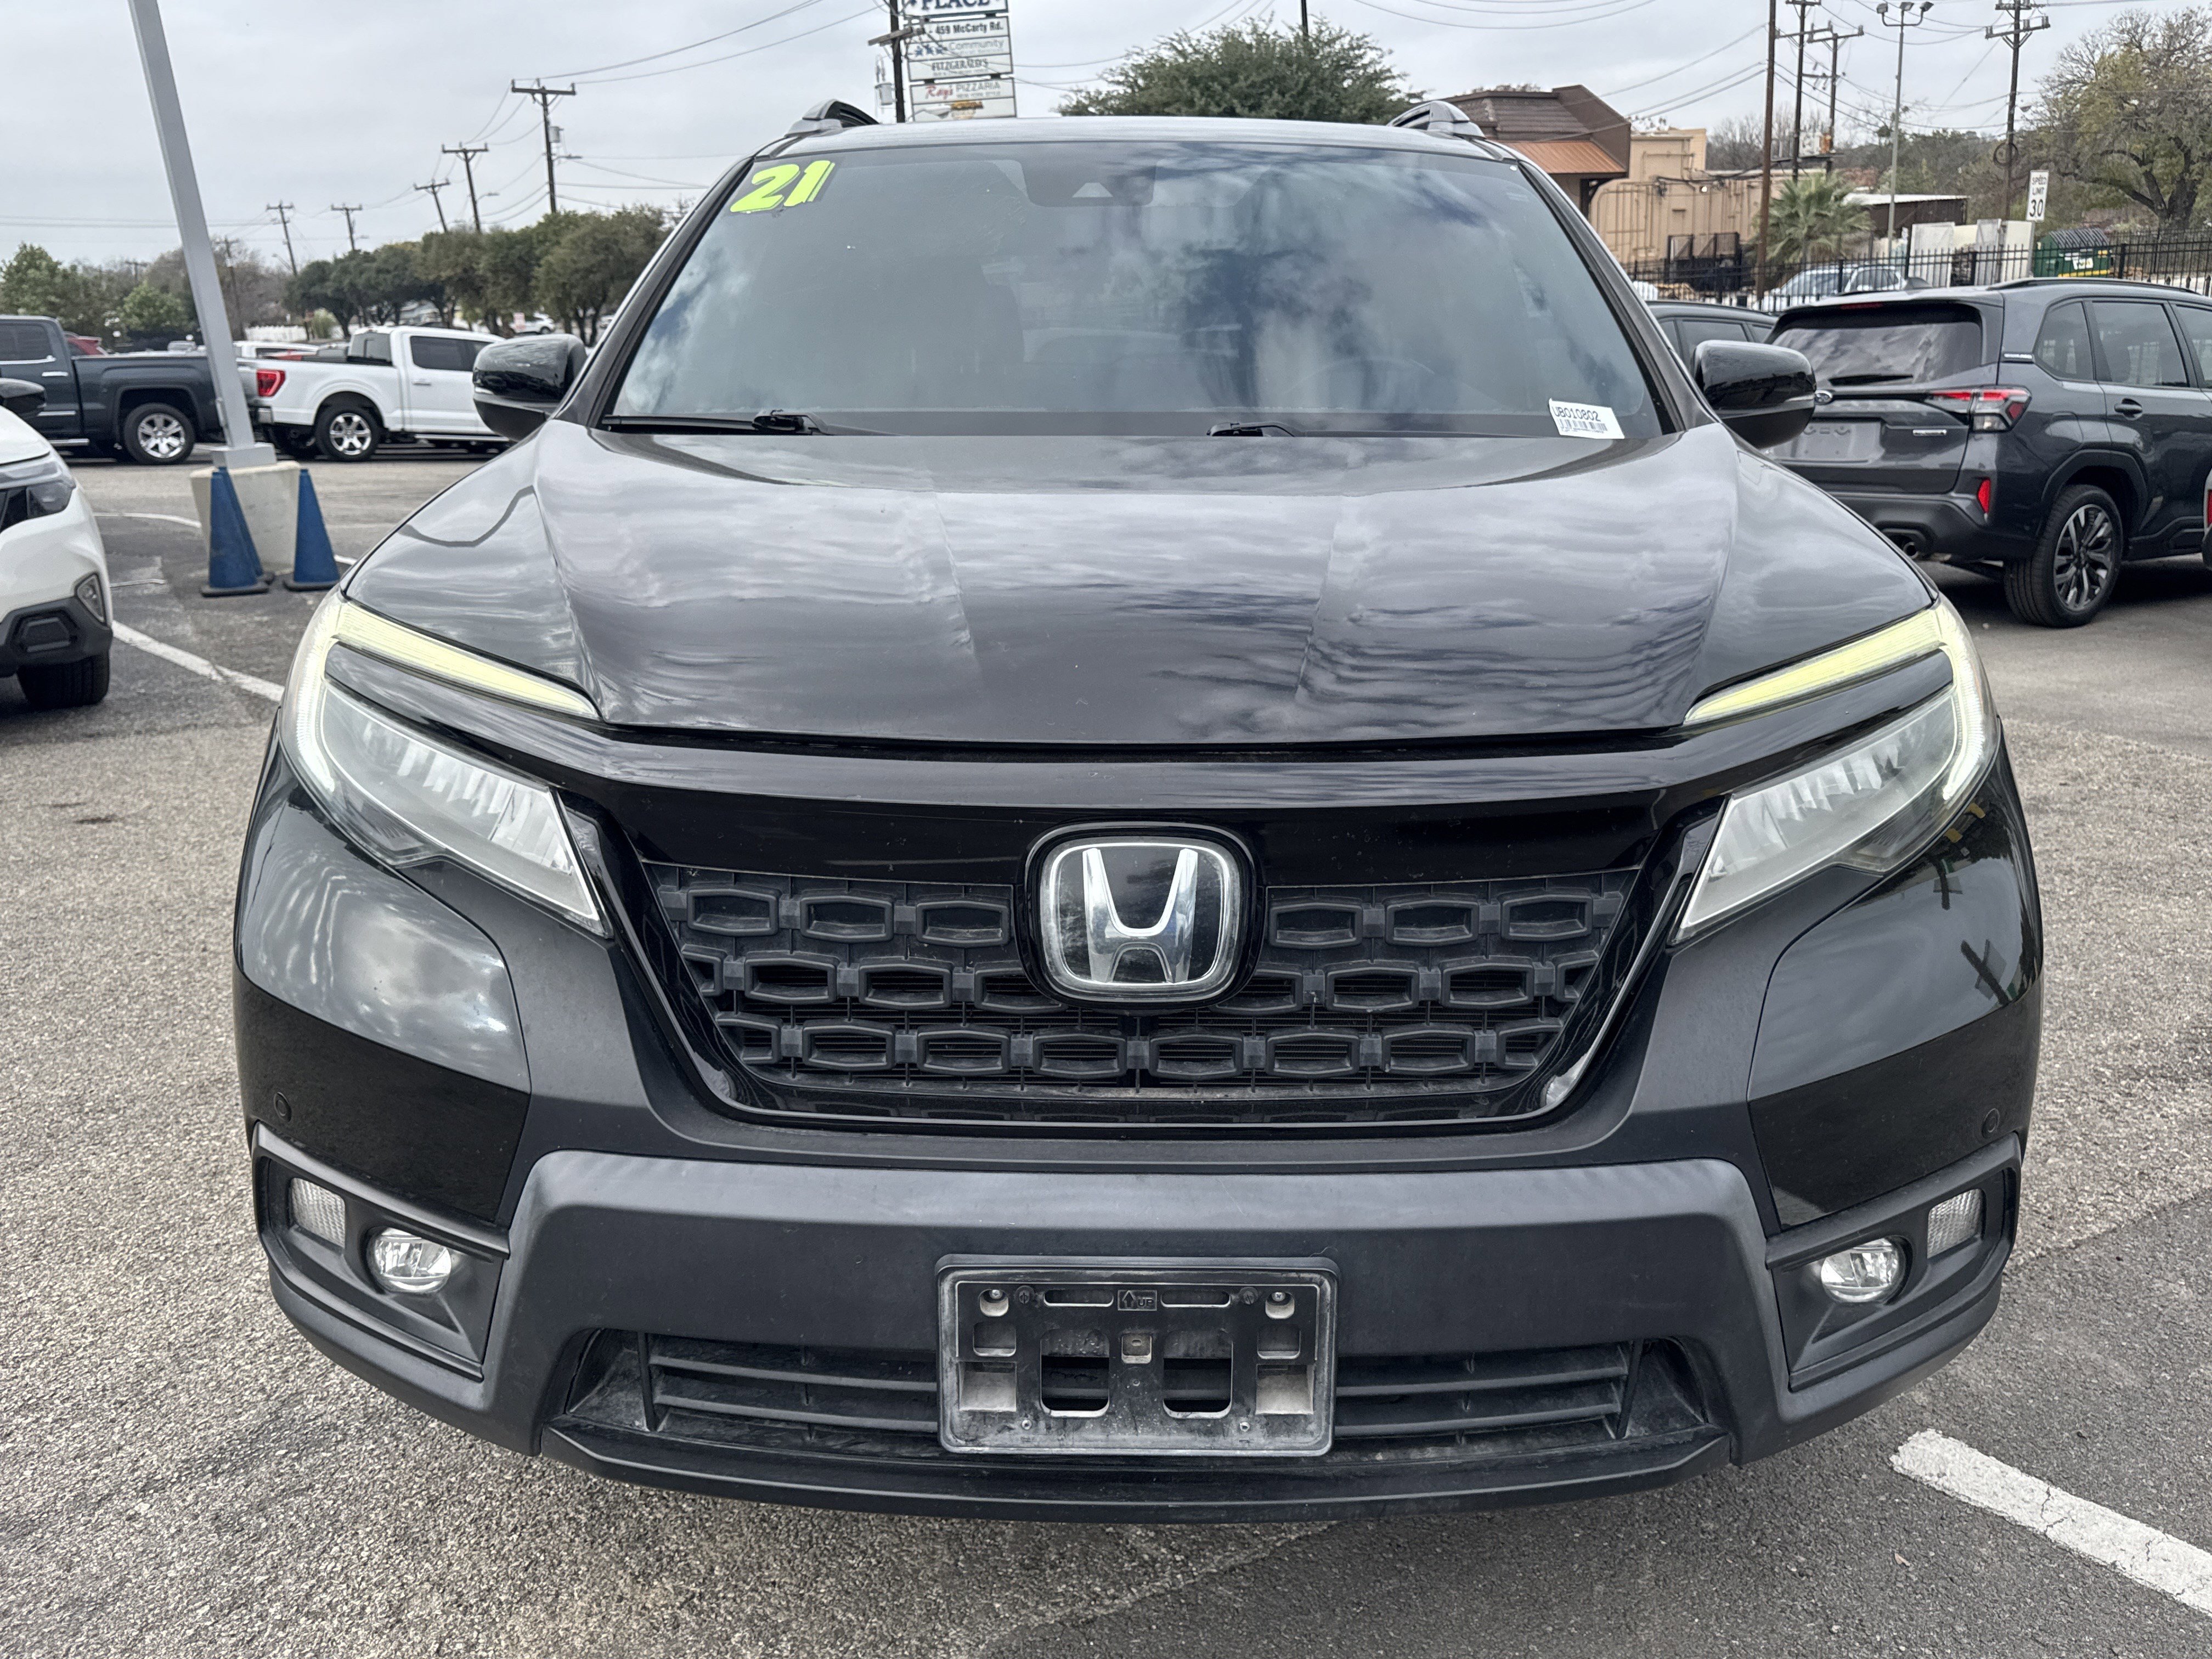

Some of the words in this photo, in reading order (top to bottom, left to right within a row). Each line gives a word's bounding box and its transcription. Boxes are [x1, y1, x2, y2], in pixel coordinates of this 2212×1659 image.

[953, 24, 987, 33] McCarty
[990, 21, 1003, 30] Rd.
[948, 39, 1004, 50] Community
[730, 160, 836, 213] 21
[2029, 199, 2044, 217] 30
[1137, 1297, 1153, 1307] UP
